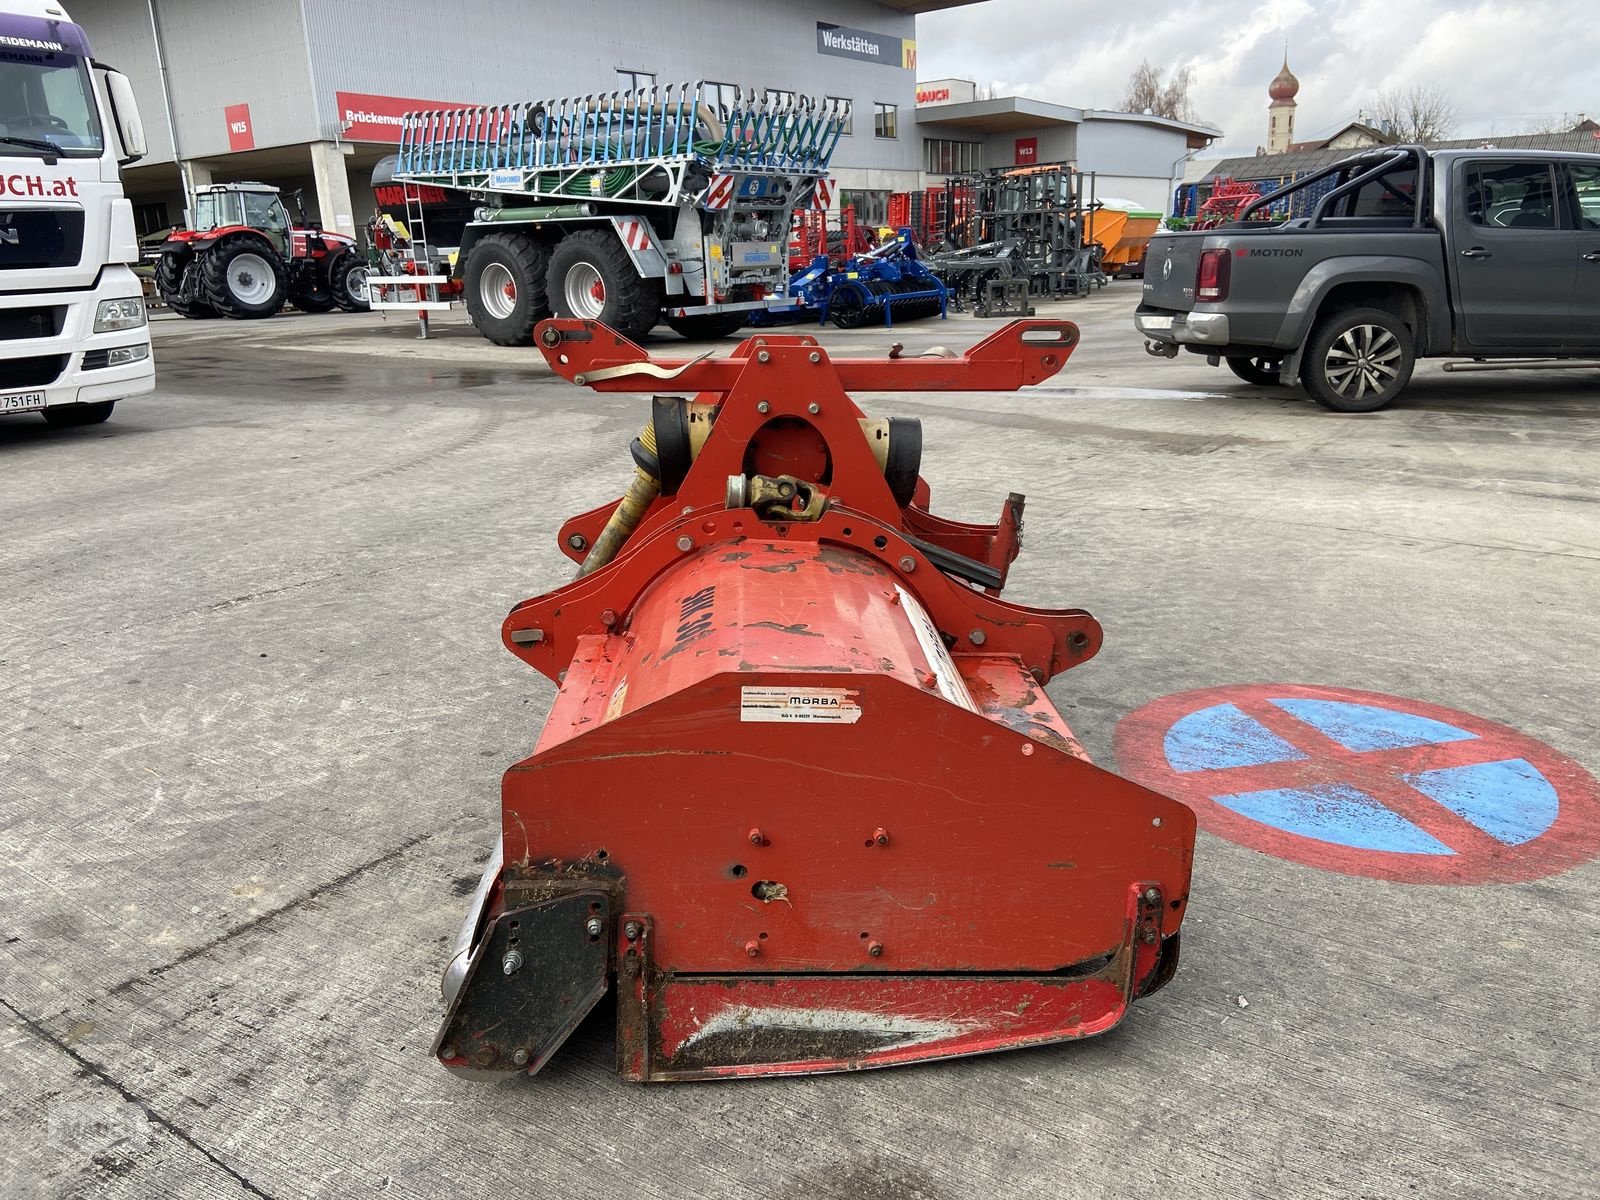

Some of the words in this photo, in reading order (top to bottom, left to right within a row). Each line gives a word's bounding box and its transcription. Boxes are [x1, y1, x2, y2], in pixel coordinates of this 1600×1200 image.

[822, 30, 880, 56] Werkstätten
[231, 121, 247, 134] W15
[1019, 147, 1033, 155] W13
[3, 394, 41, 408] 751FH
[789, 696, 839, 706] MÖRBA
